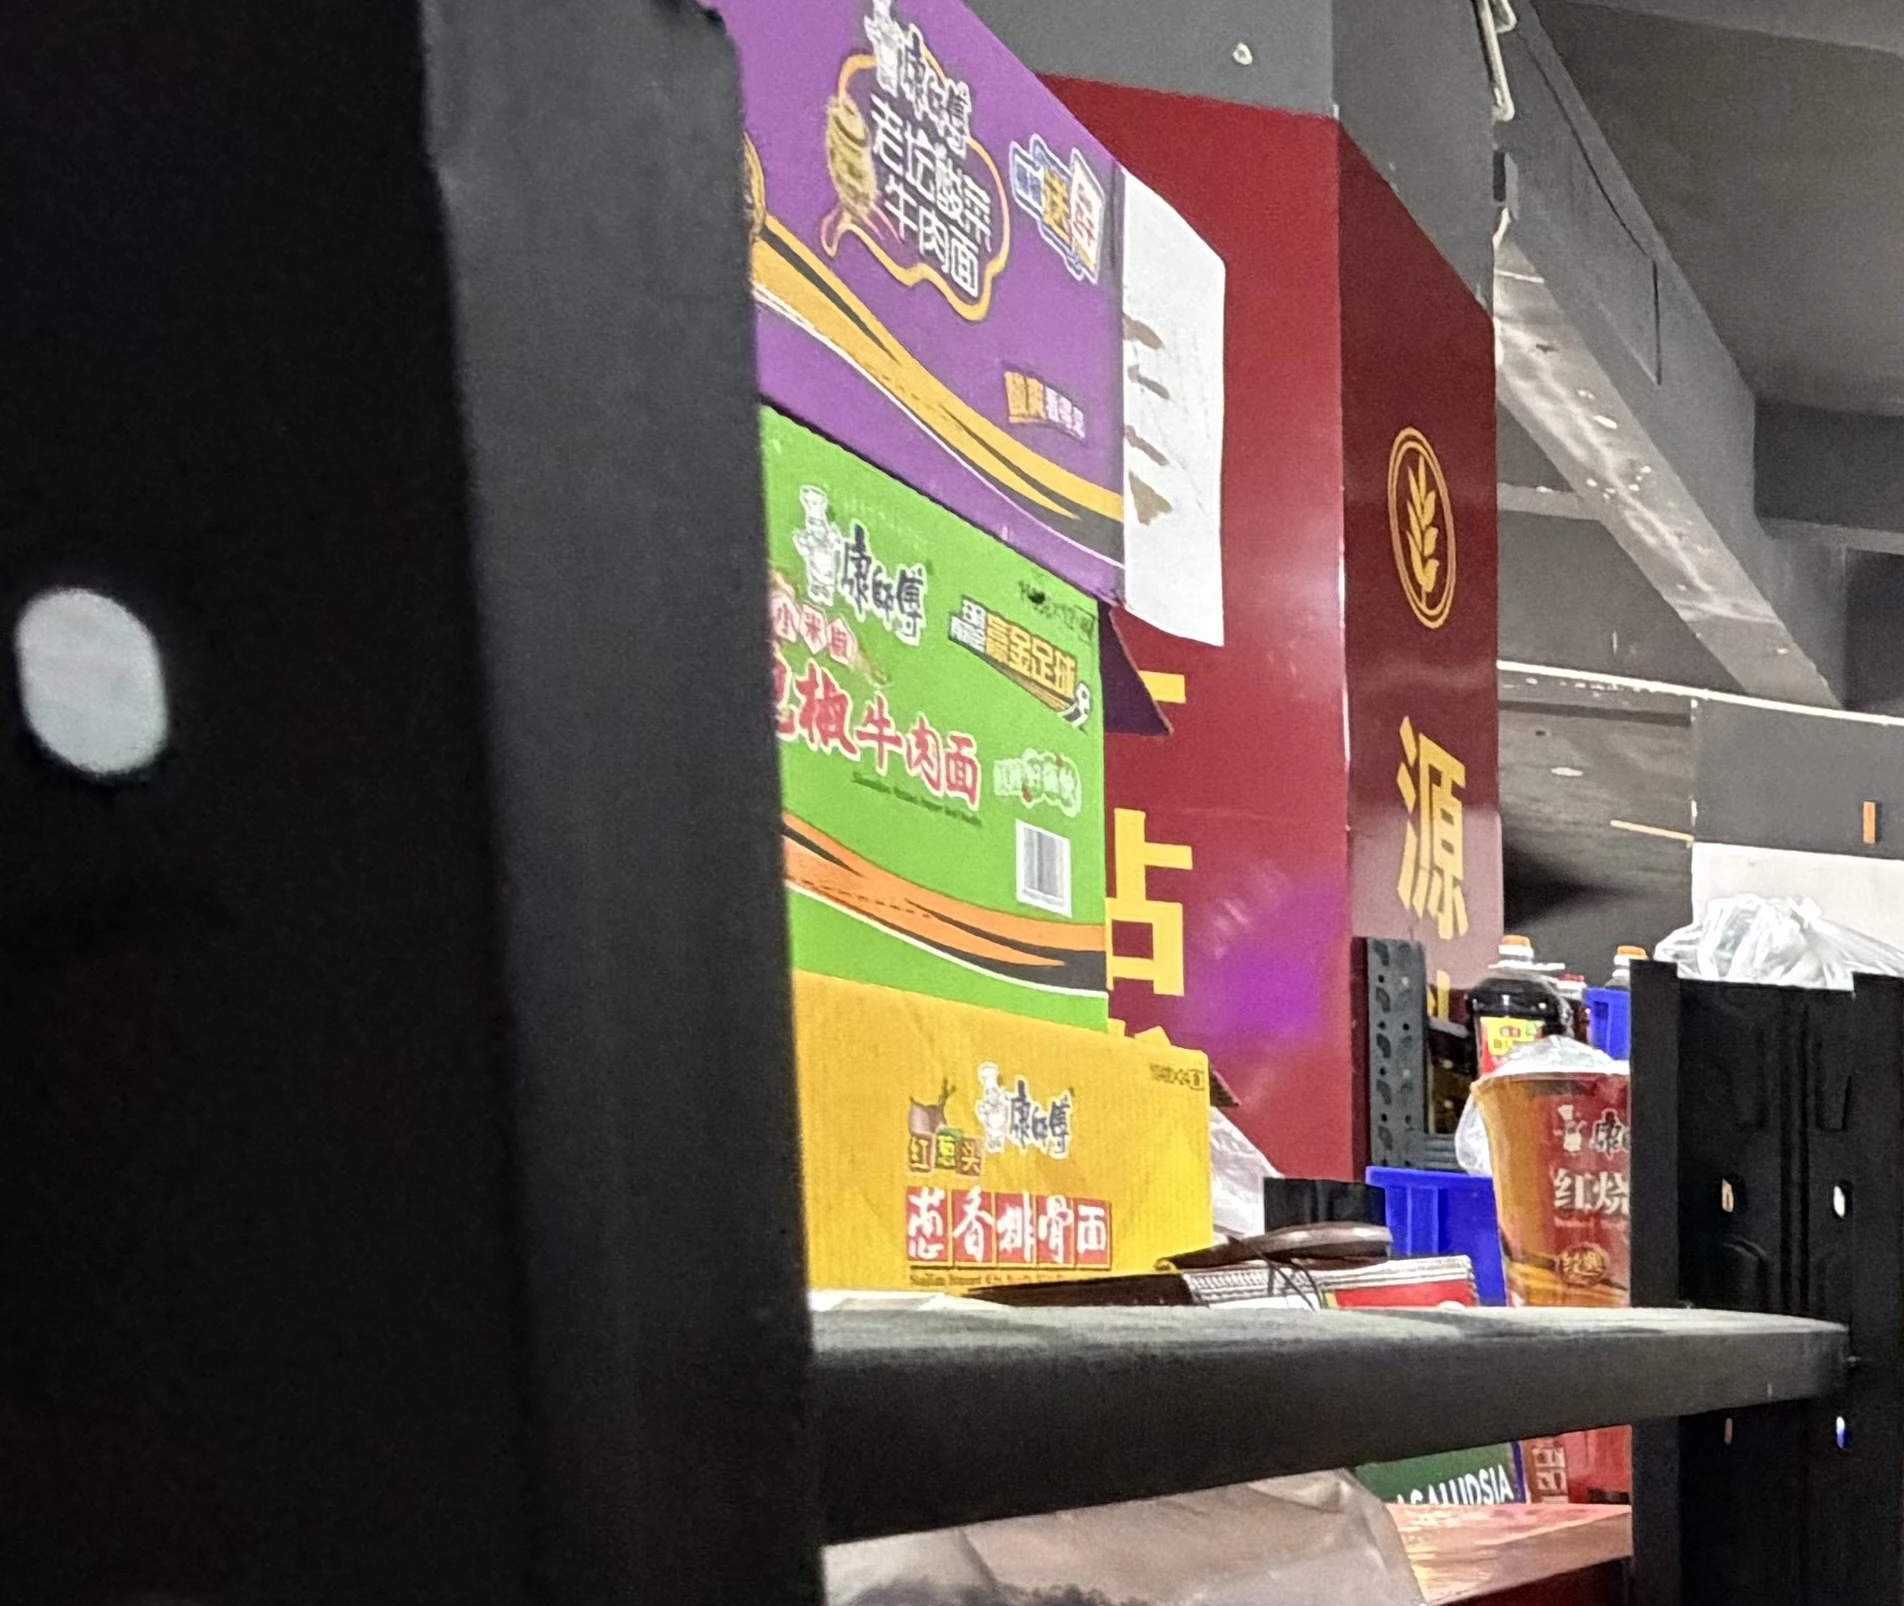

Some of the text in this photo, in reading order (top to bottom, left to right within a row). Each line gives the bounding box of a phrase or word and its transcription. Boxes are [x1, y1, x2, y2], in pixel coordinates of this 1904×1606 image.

[885, 175, 980, 298] 牛肉面
[1396, 714, 1468, 941] 源
[906, 1184, 1110, 1264] 葱香排骨面
